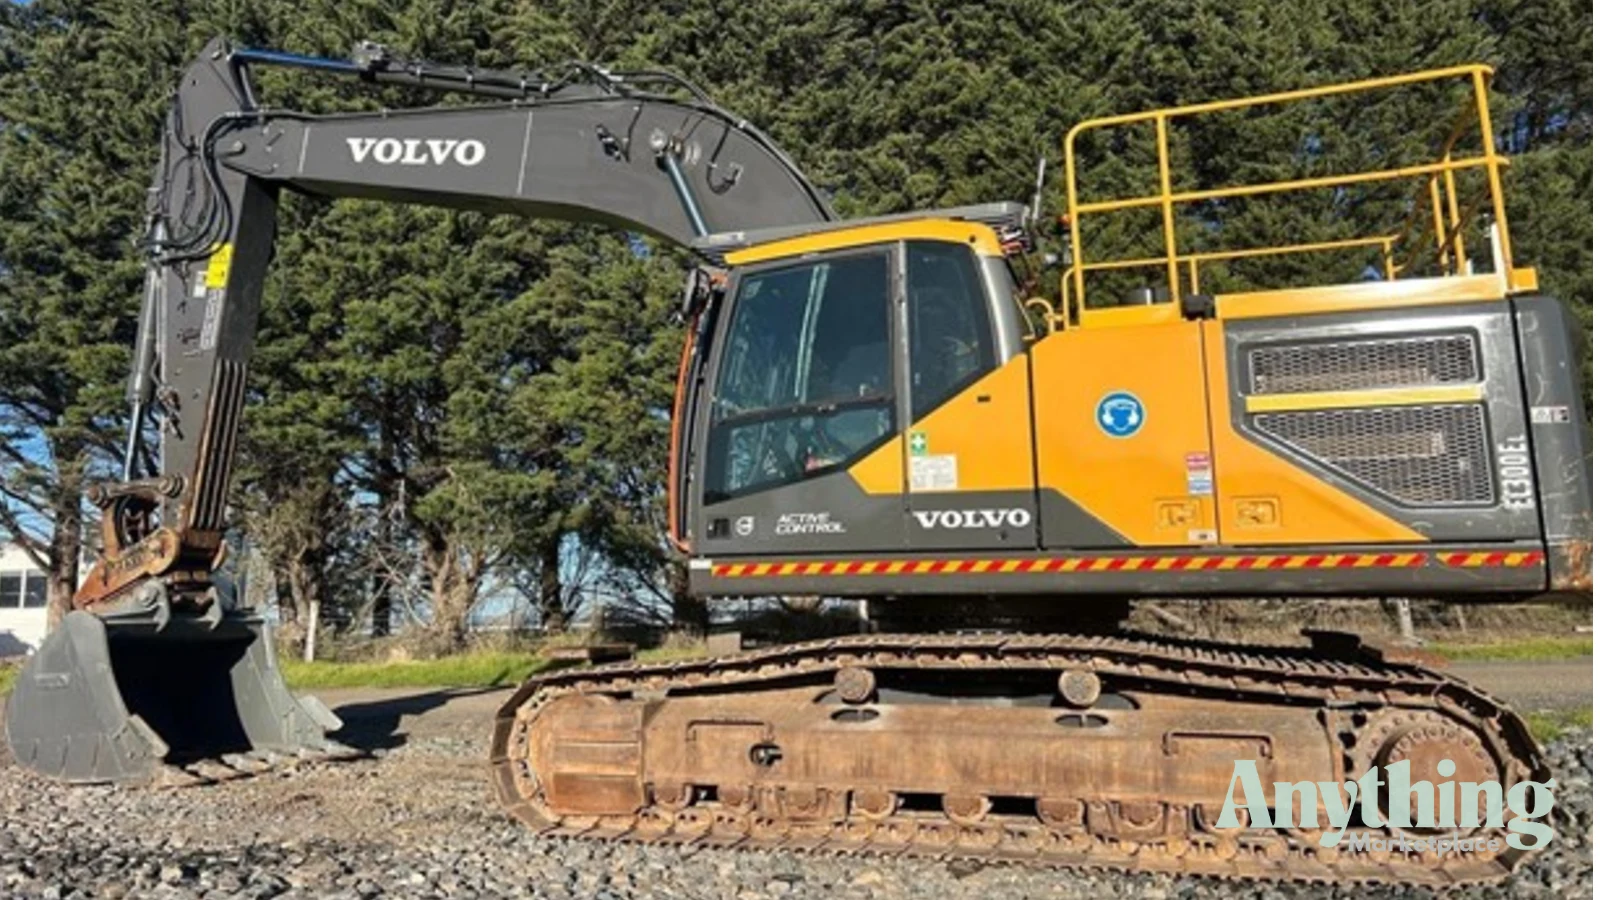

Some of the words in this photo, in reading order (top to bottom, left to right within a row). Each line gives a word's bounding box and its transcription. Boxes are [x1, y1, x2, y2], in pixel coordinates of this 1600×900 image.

[346, 137, 486, 166] VOLVO
[777, 512, 830, 525] ACTIVE
[912, 508, 1031, 528] VOLVO
[775, 523, 847, 535] CONTROL
